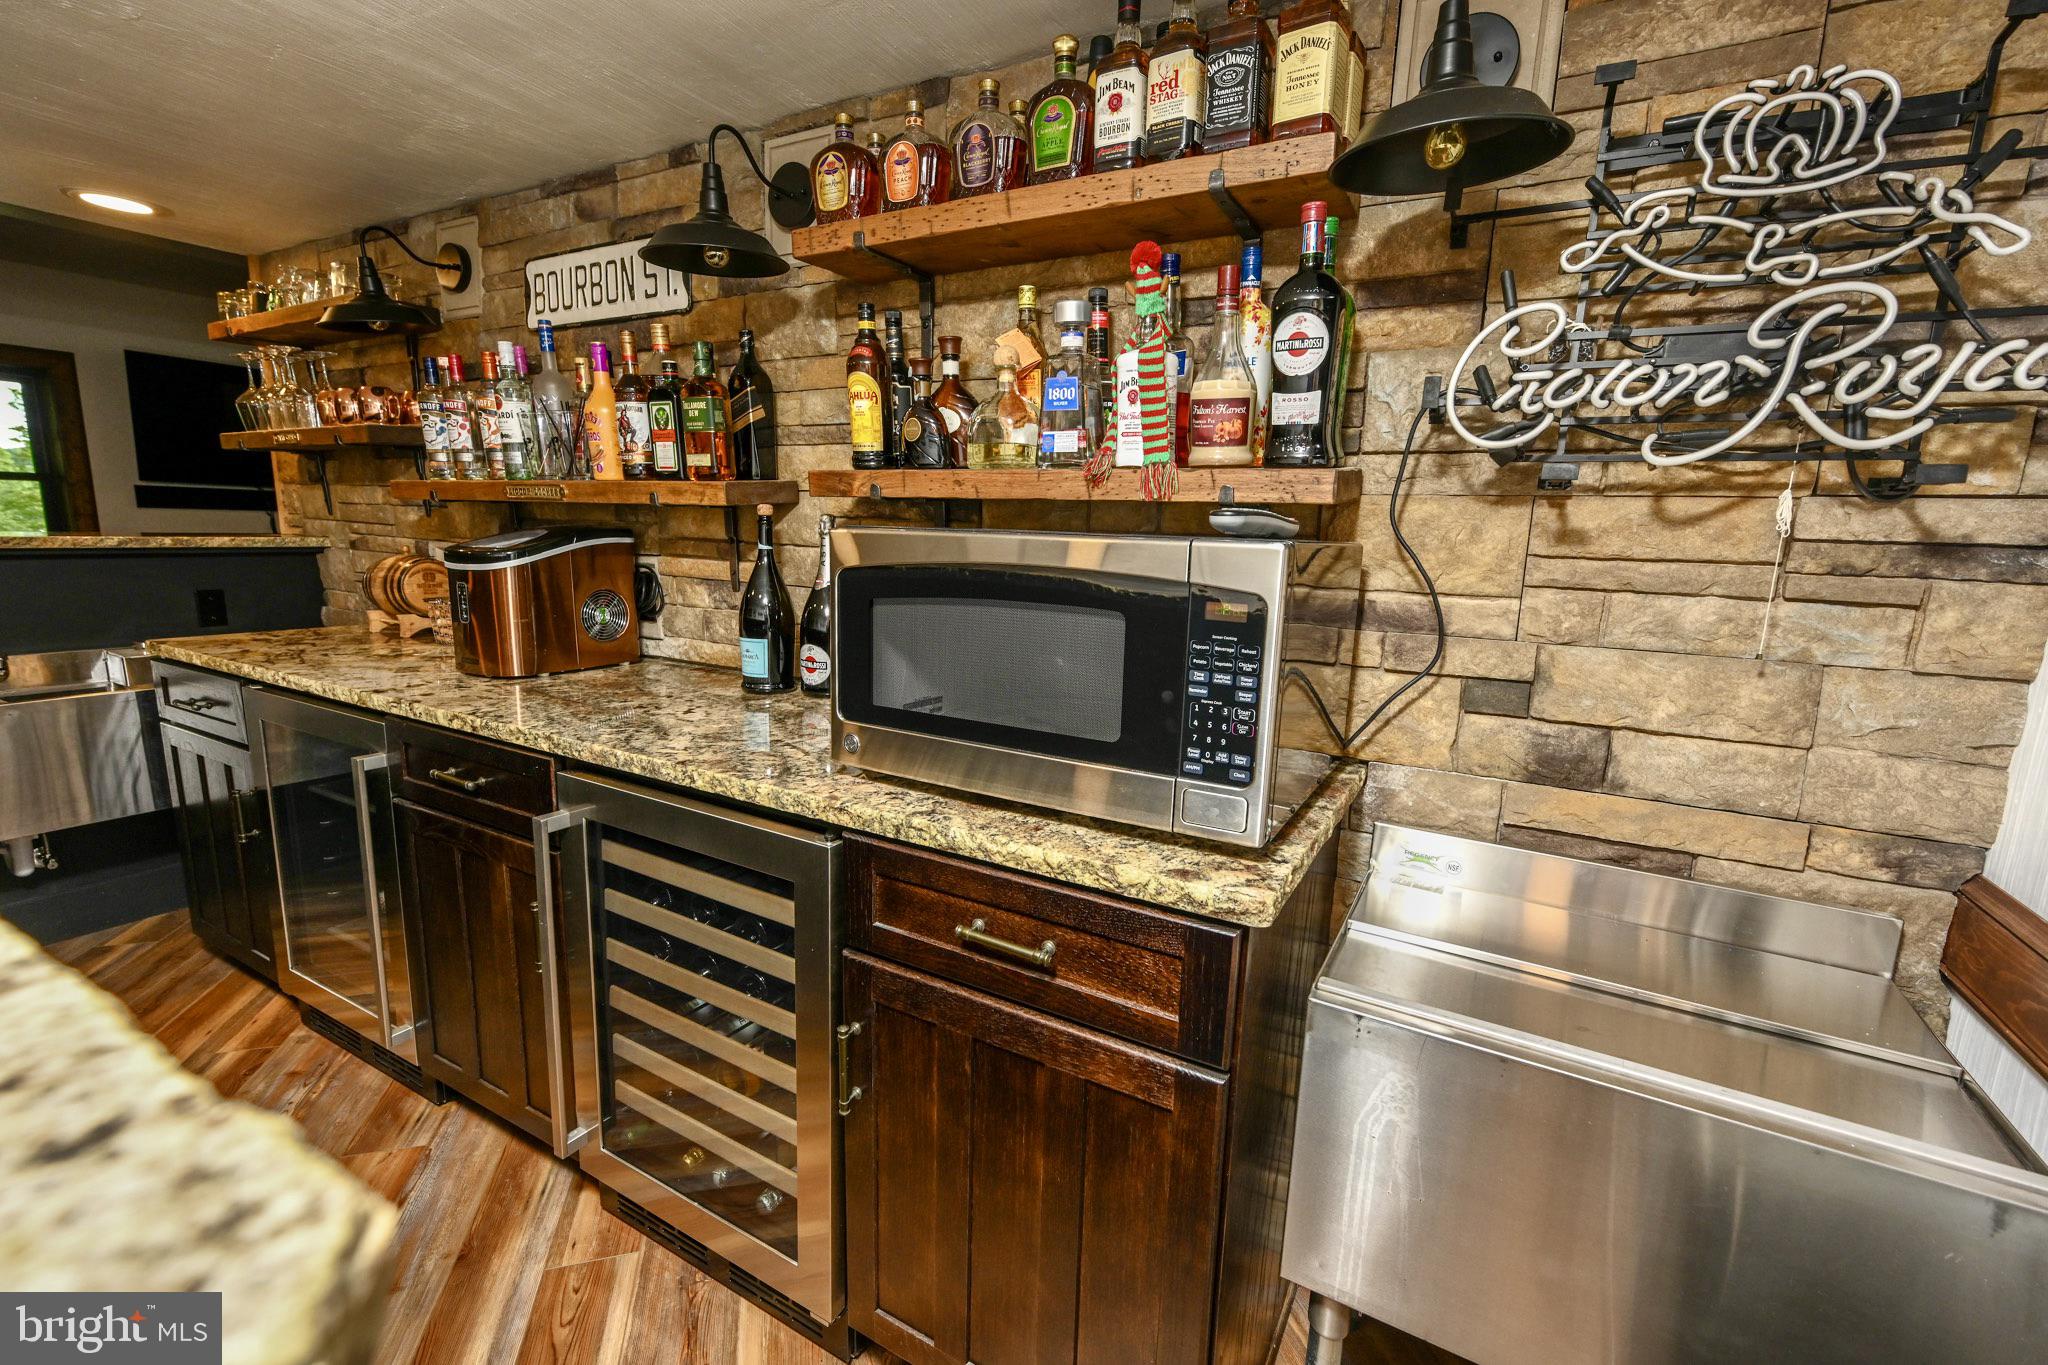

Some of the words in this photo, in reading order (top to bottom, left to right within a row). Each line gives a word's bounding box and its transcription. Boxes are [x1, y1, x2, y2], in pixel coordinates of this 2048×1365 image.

[1280, 42, 1299, 62] JACK
[1300, 36, 1332, 50] DANIEL'S
[1208, 57, 1225, 76] JACK
[1226, 53, 1255, 67] DANIEL'S
[1150, 68, 1179, 95] red
[1287, 72, 1319, 84] Tennessee
[1098, 82, 1111, 103] JIM
[1113, 78, 1135, 94] BEAM
[1213, 86, 1244, 96] Tennessee
[1286, 79, 1319, 92] HONEY
[1149, 90, 1178, 106] STAG
[1213, 95, 1243, 106] WHISKEY
[1099, 122, 1130, 138] BOURBON
[1042, 139, 1063, 148] APPLE
[534, 255, 635, 315] BOURBON
[1447, 302, 1770, 450] Crown
[1643, 282, 2048, 466] Roya
[1048, 387, 1075, 400] 1800
[1120, 381, 1130, 394] JIM
[848, 388, 878, 405] AHLÚA
[682, 401, 706, 409] TULLAMORE
[1216, 404, 1246, 414] Harvest
